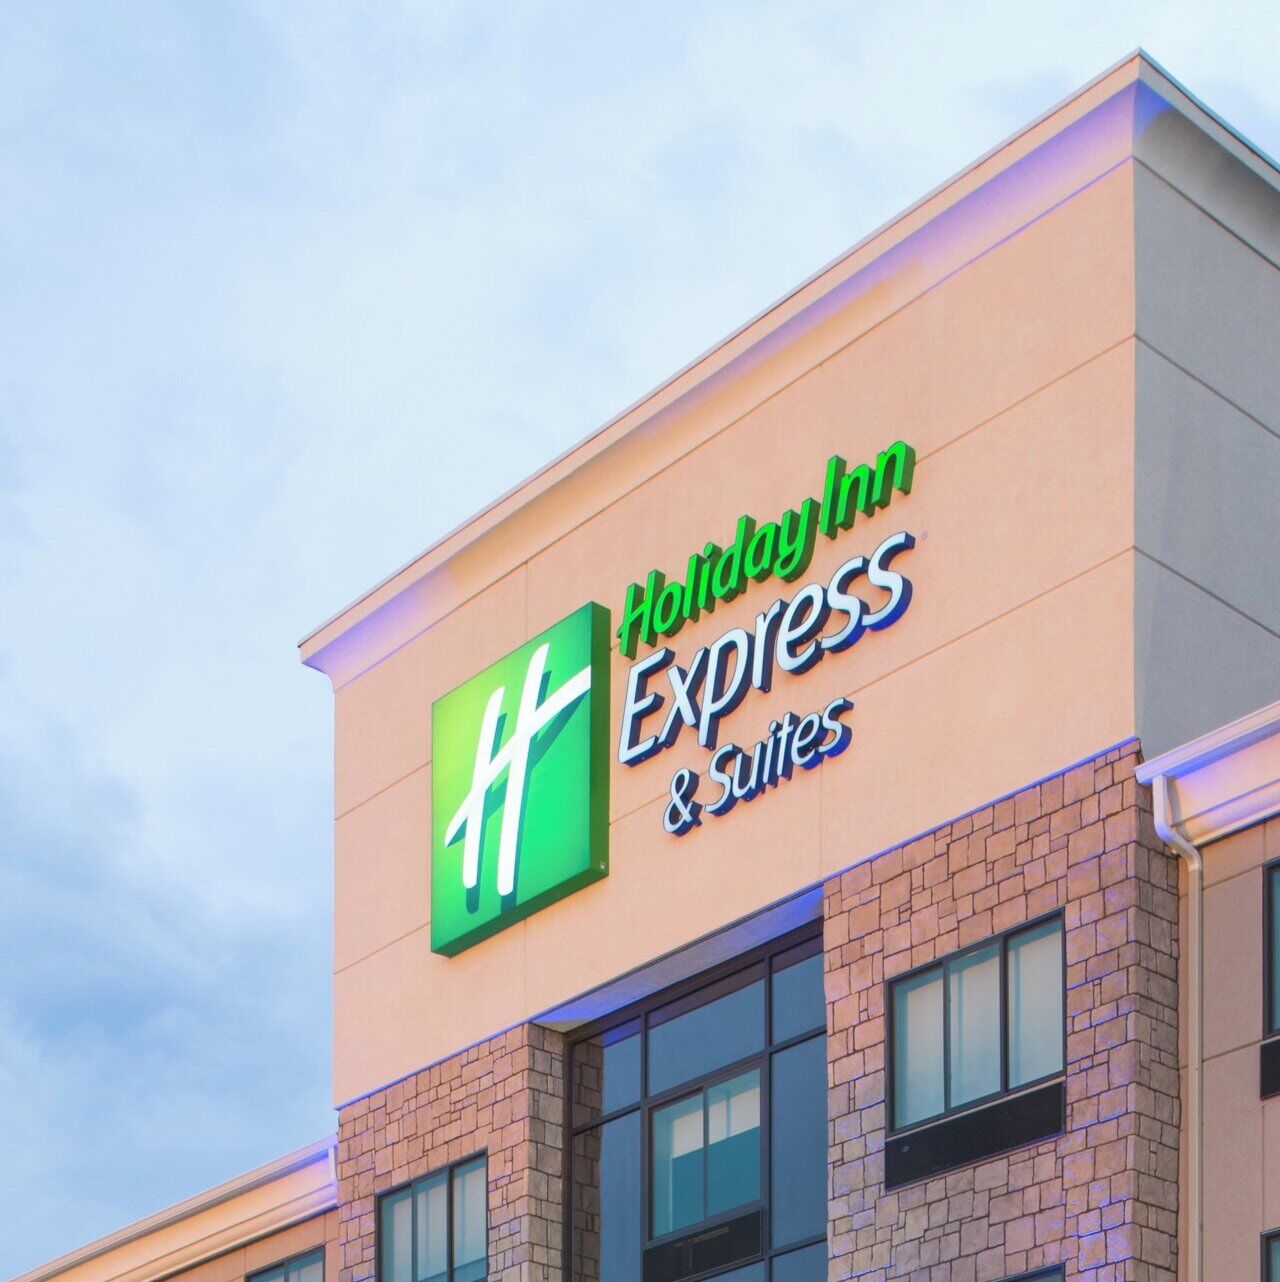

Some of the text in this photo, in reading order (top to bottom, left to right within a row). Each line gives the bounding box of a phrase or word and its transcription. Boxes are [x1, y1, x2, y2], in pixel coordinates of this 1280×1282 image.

[617, 441, 916, 659] Holiday Inn
[618, 531, 916, 766] Express
[663, 697, 854, 836] & Suites
